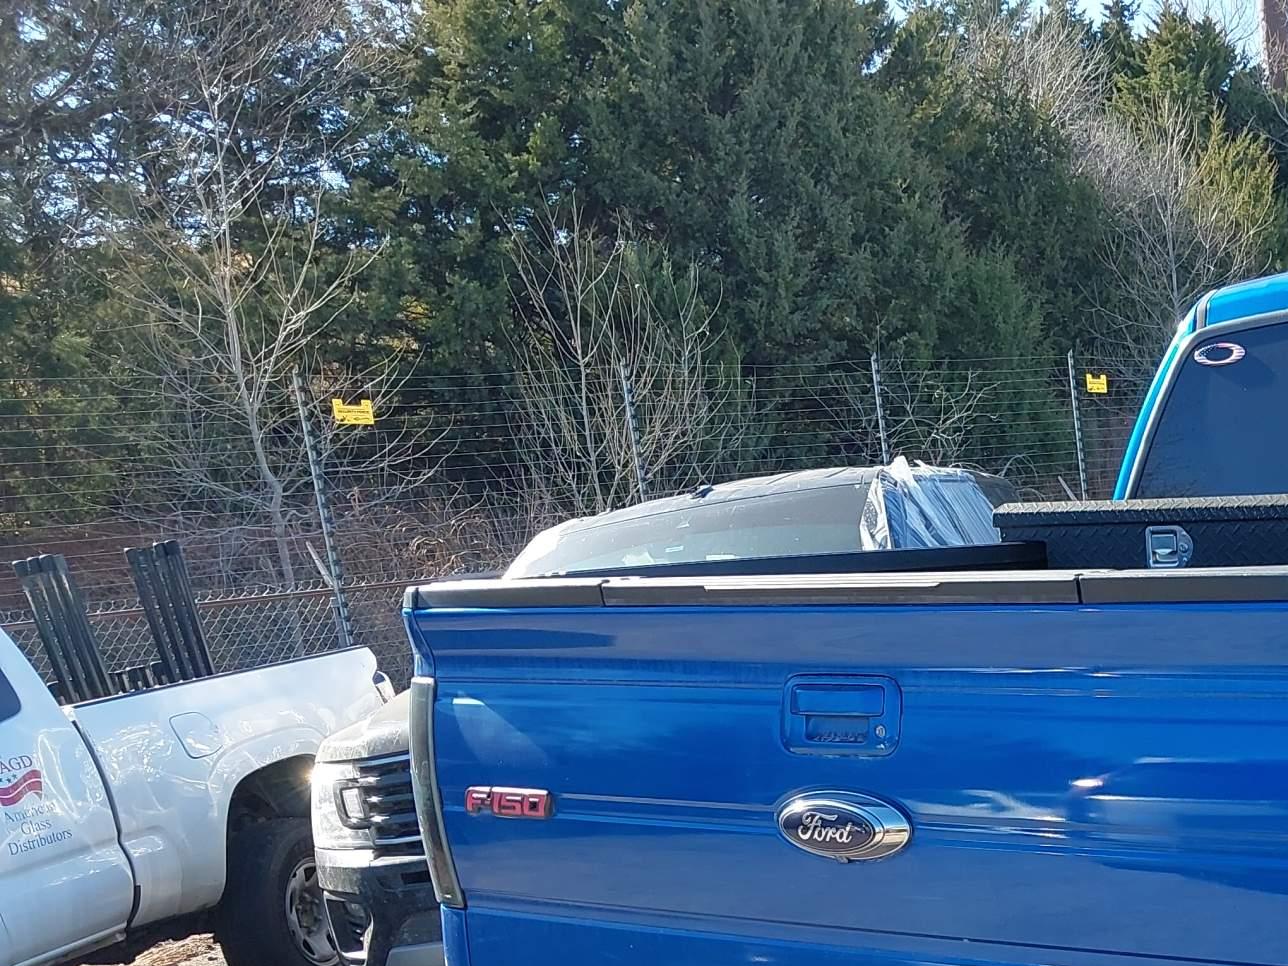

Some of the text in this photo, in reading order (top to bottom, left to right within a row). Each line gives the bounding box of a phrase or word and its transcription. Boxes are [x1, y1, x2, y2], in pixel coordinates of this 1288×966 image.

[0, 755, 33, 774] AGD
[20, 819, 52, 835] Glass
[797, 811, 854, 843] Ford
[8, 829, 73, 856] Distributors
